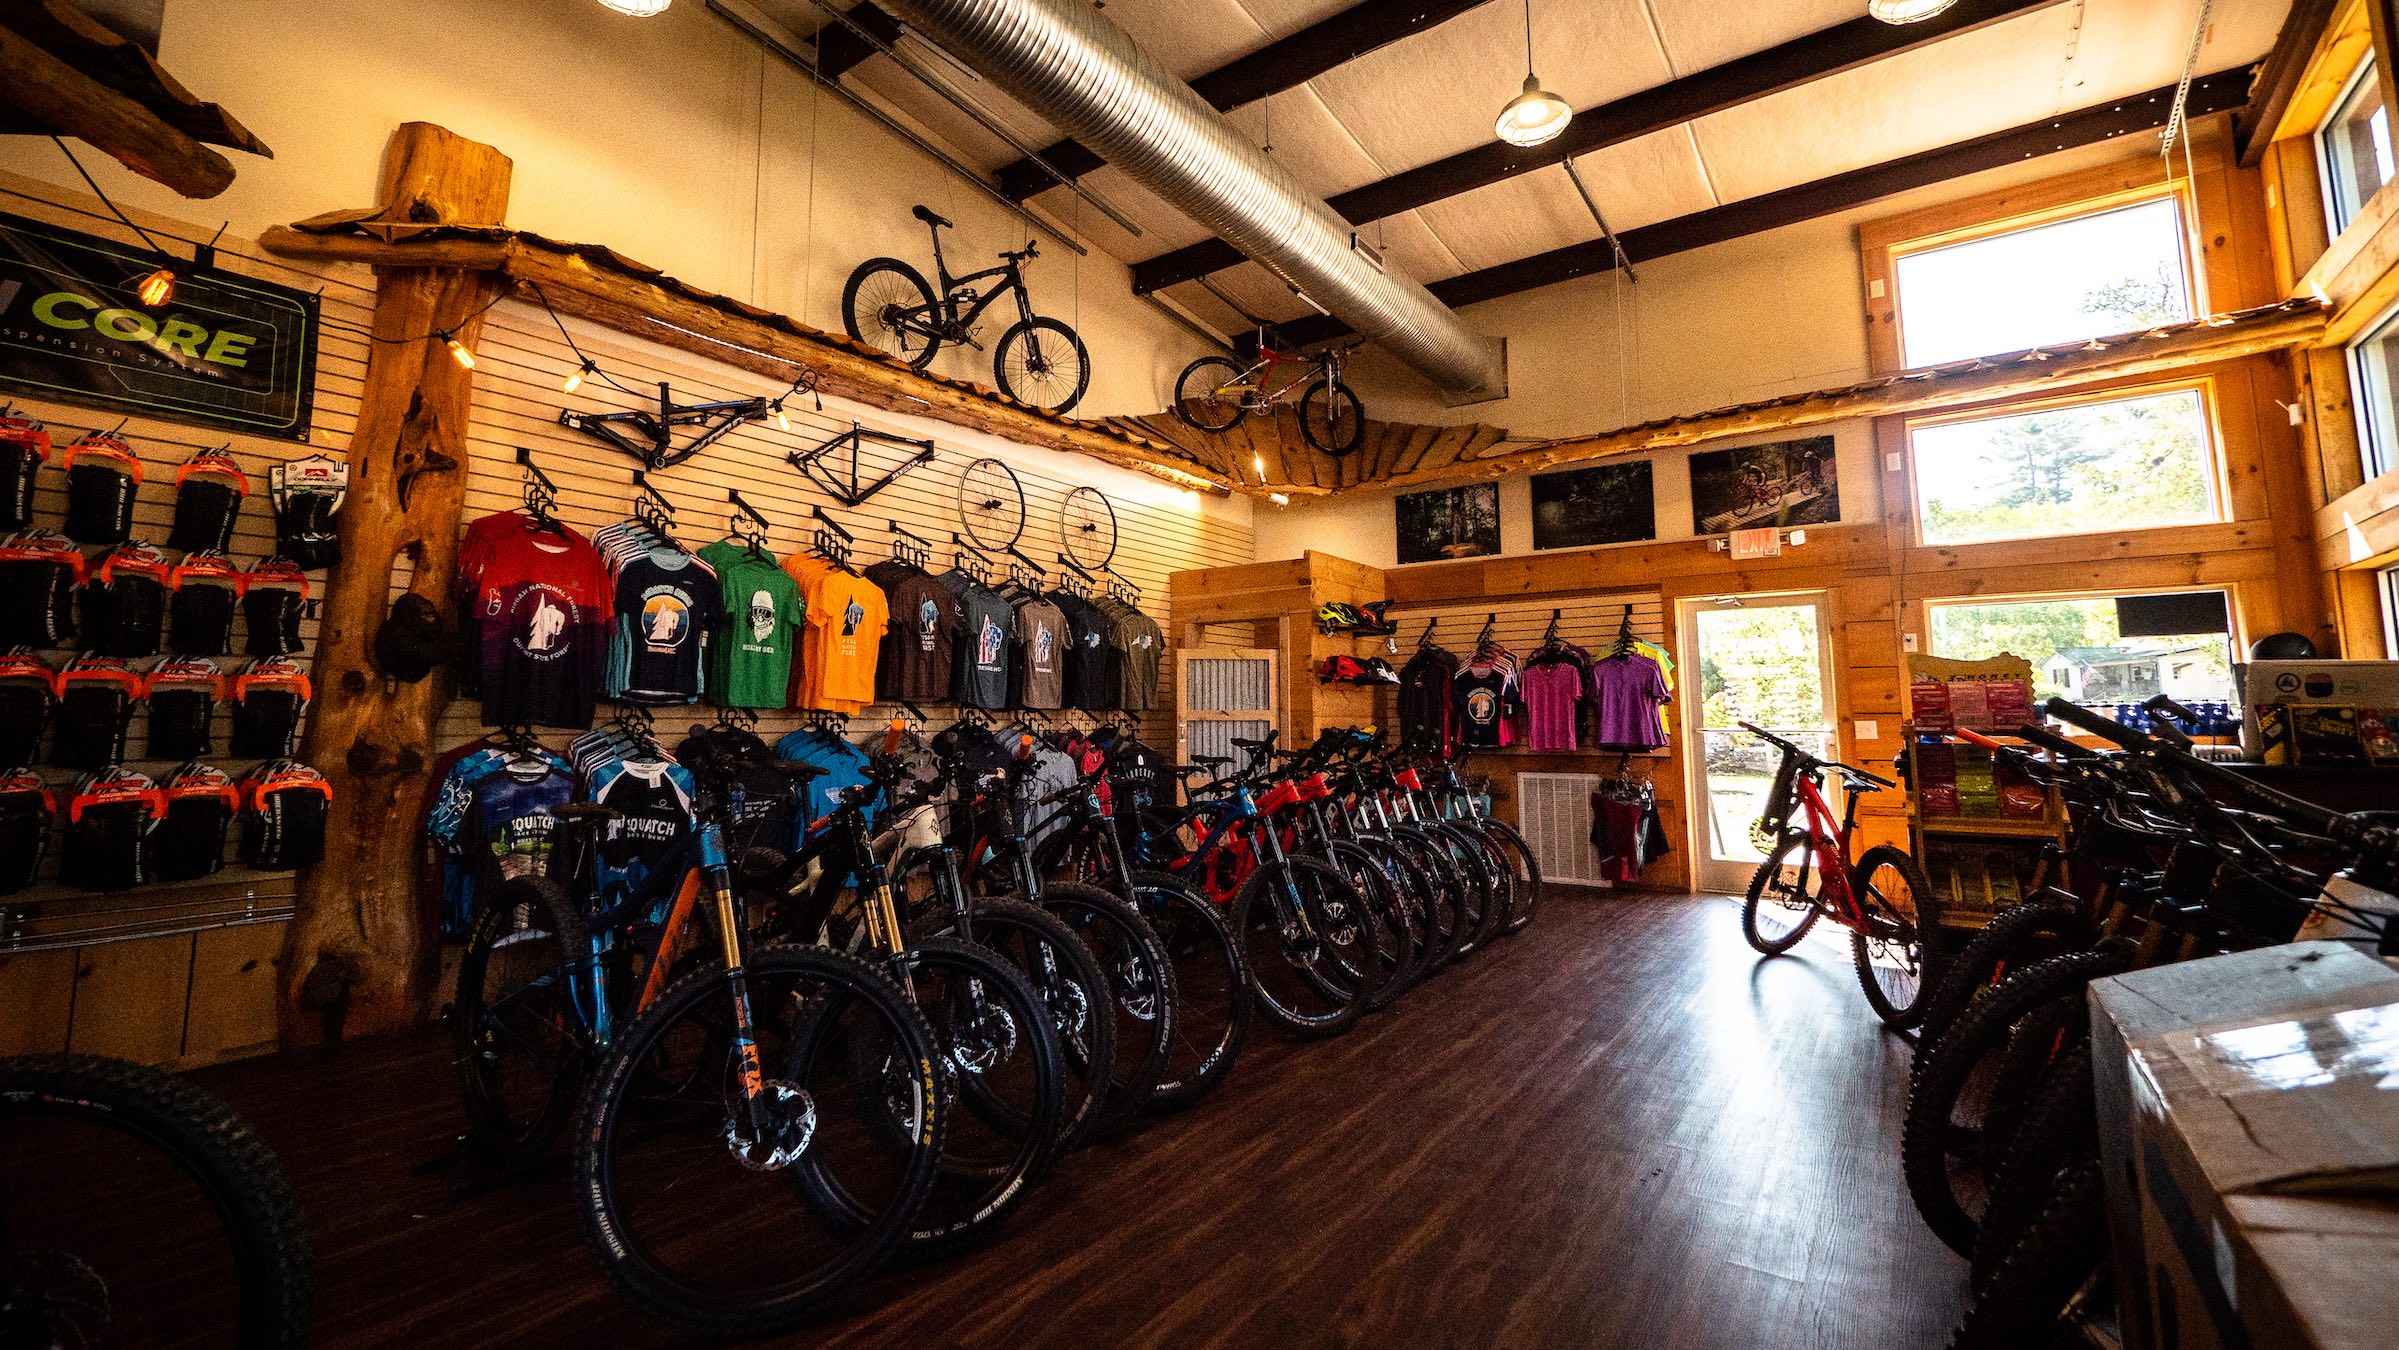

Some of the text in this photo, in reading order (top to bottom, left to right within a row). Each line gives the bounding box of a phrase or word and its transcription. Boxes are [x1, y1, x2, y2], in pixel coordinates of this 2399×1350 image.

[32, 291, 257, 368] CORE
[1738, 529, 1771, 553] EXIT
[529, 583, 566, 597] NATIONAL
[627, 817, 676, 837] SQUATCH
[738, 1043, 763, 1100] FOX
[921, 1057, 935, 1147] MAXXIS
